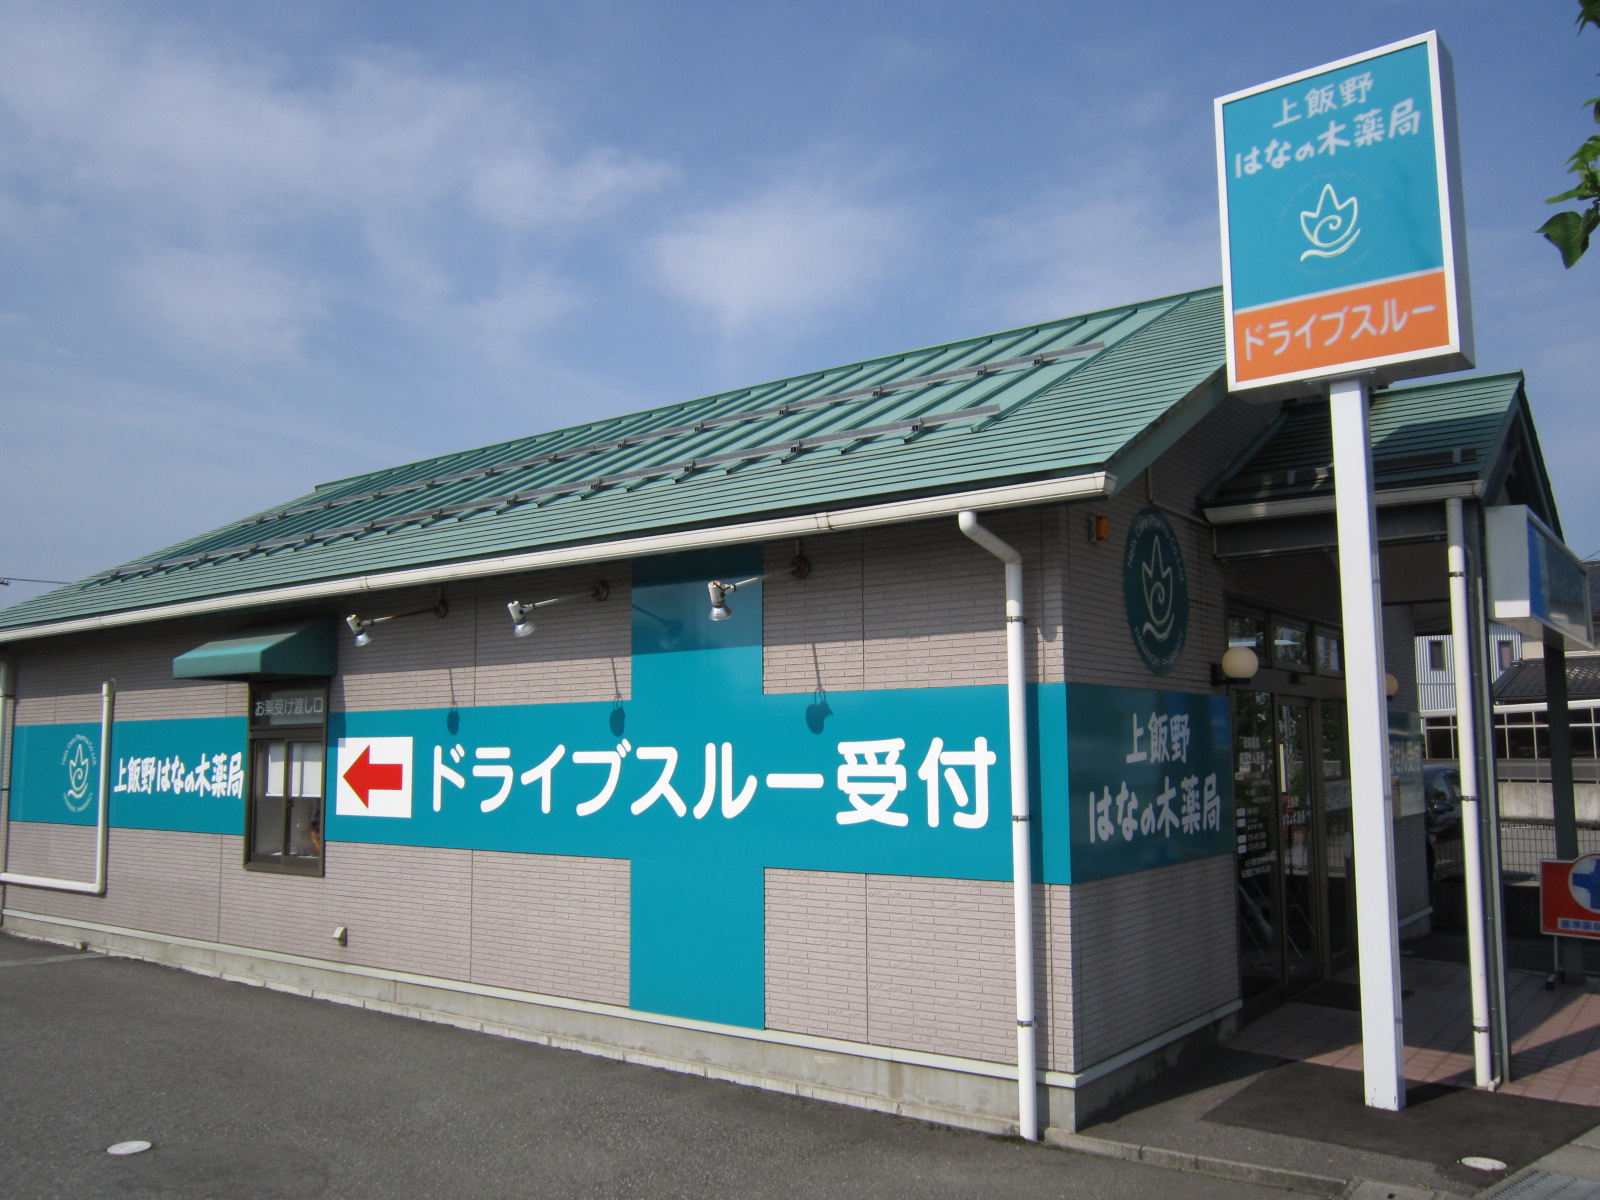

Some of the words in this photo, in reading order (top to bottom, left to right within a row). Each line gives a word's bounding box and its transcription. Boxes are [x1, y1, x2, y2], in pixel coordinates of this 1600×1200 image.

[1272, 71, 1374, 128] 上飯野
[1235, 97, 1421, 178] はなの木薬局
[1245, 298, 1437, 361] ドライブスルー
[1135, 518, 1149, 537] Care
[255, 696, 324, 717] お薬受け渡し口
[1126, 713, 1191, 765] 上飯野
[113, 751, 244, 800] 上飯野はなの木薬局
[432, 736, 997, 829] ドライブスルー受付
[1089, 772, 1221, 844] はなの木薬局
